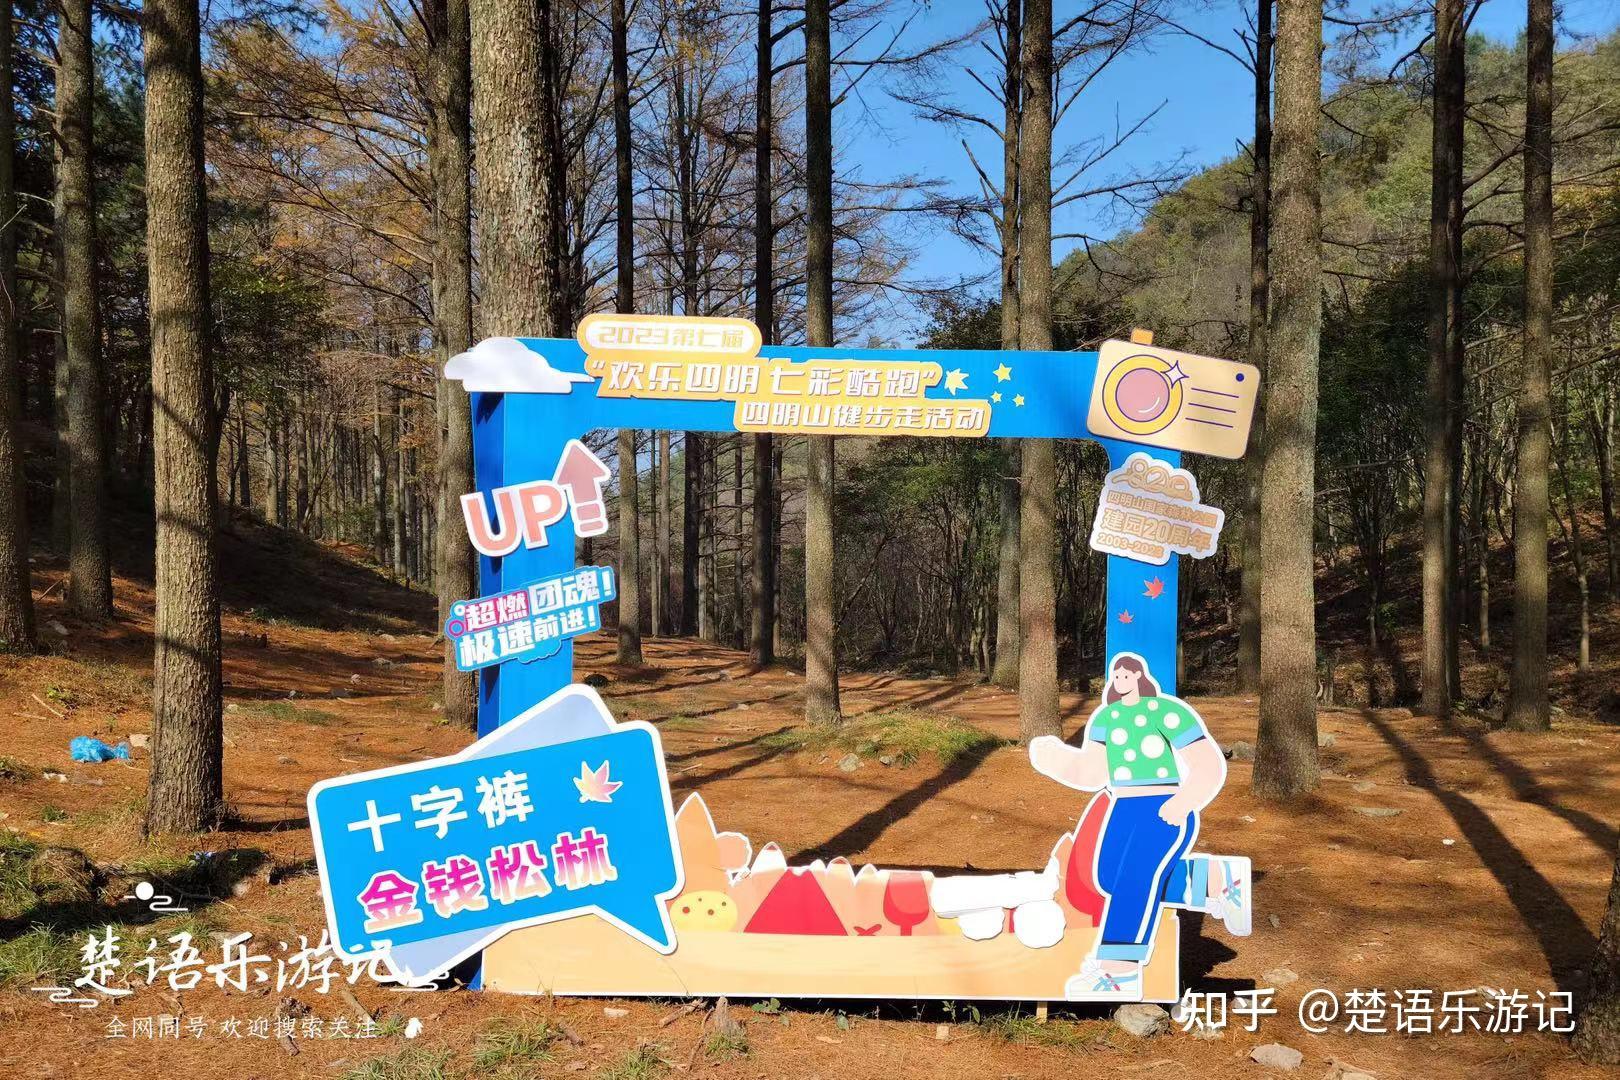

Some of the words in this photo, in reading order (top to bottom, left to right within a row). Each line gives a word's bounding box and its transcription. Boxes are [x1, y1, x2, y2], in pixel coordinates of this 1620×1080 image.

[598, 325, 746, 349] 2023第七届
[741, 401, 985, 430] 四明山健步走活动
[1100, 508, 1212, 552] 建园20周年
[347, 769, 535, 853] 十字裤
[358, 827, 618, 933] 金钱松林
